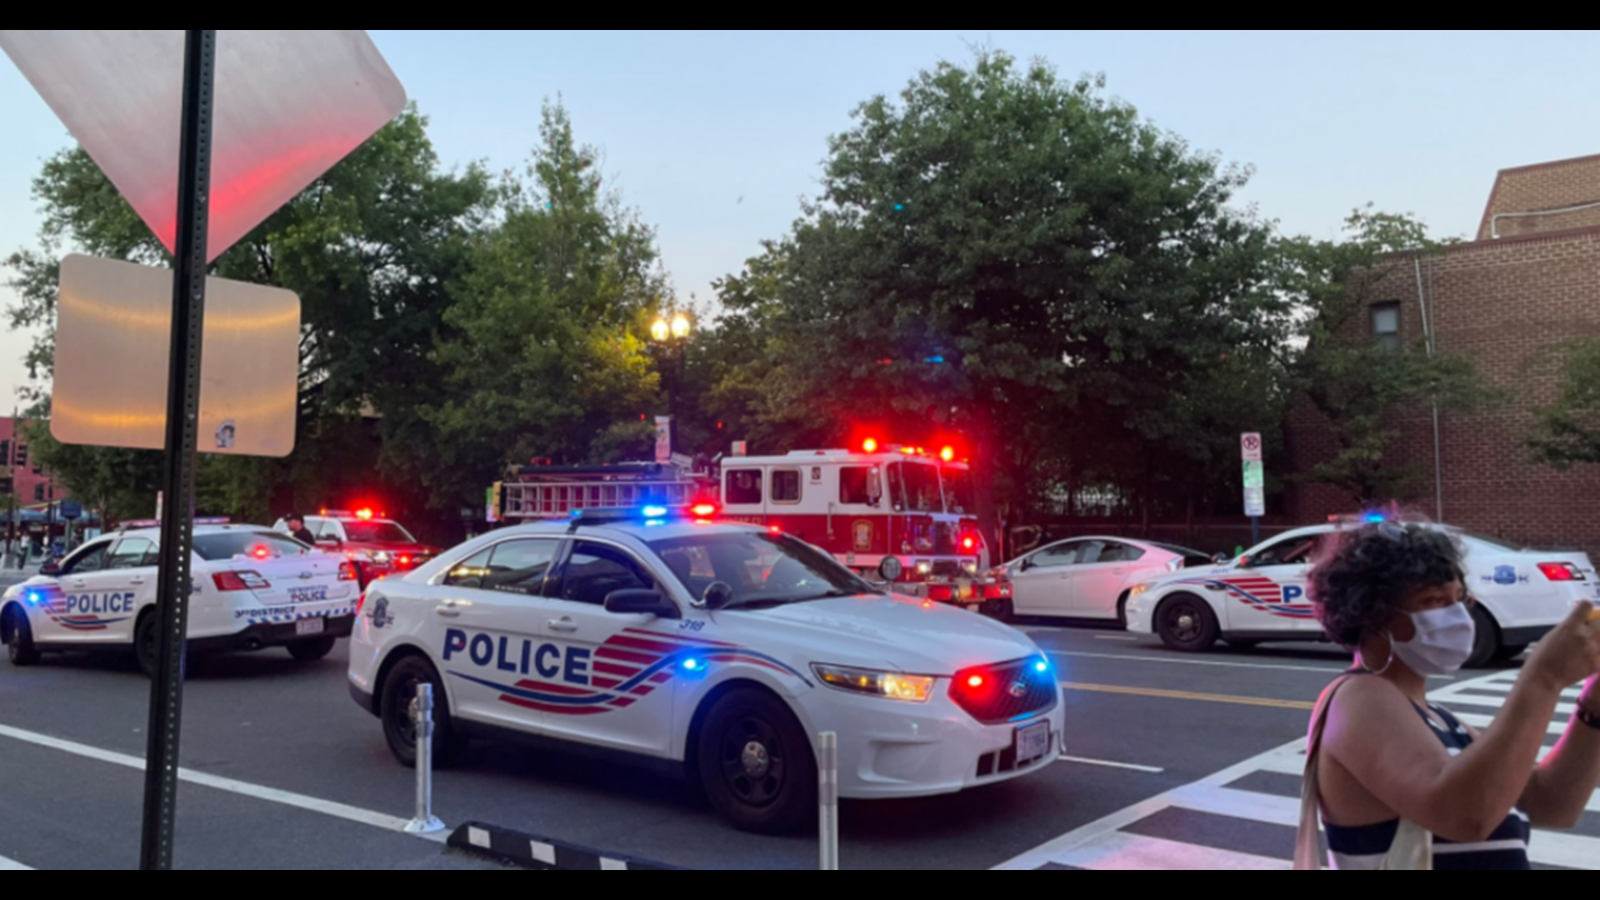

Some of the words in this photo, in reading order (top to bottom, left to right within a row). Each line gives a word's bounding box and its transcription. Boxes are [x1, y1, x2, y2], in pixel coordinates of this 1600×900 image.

[66, 593, 135, 613] POLICE
[291, 590, 326, 602] POLICE
[250, 606, 296, 617] DISTRICT
[443, 628, 591, 685] POLICE
